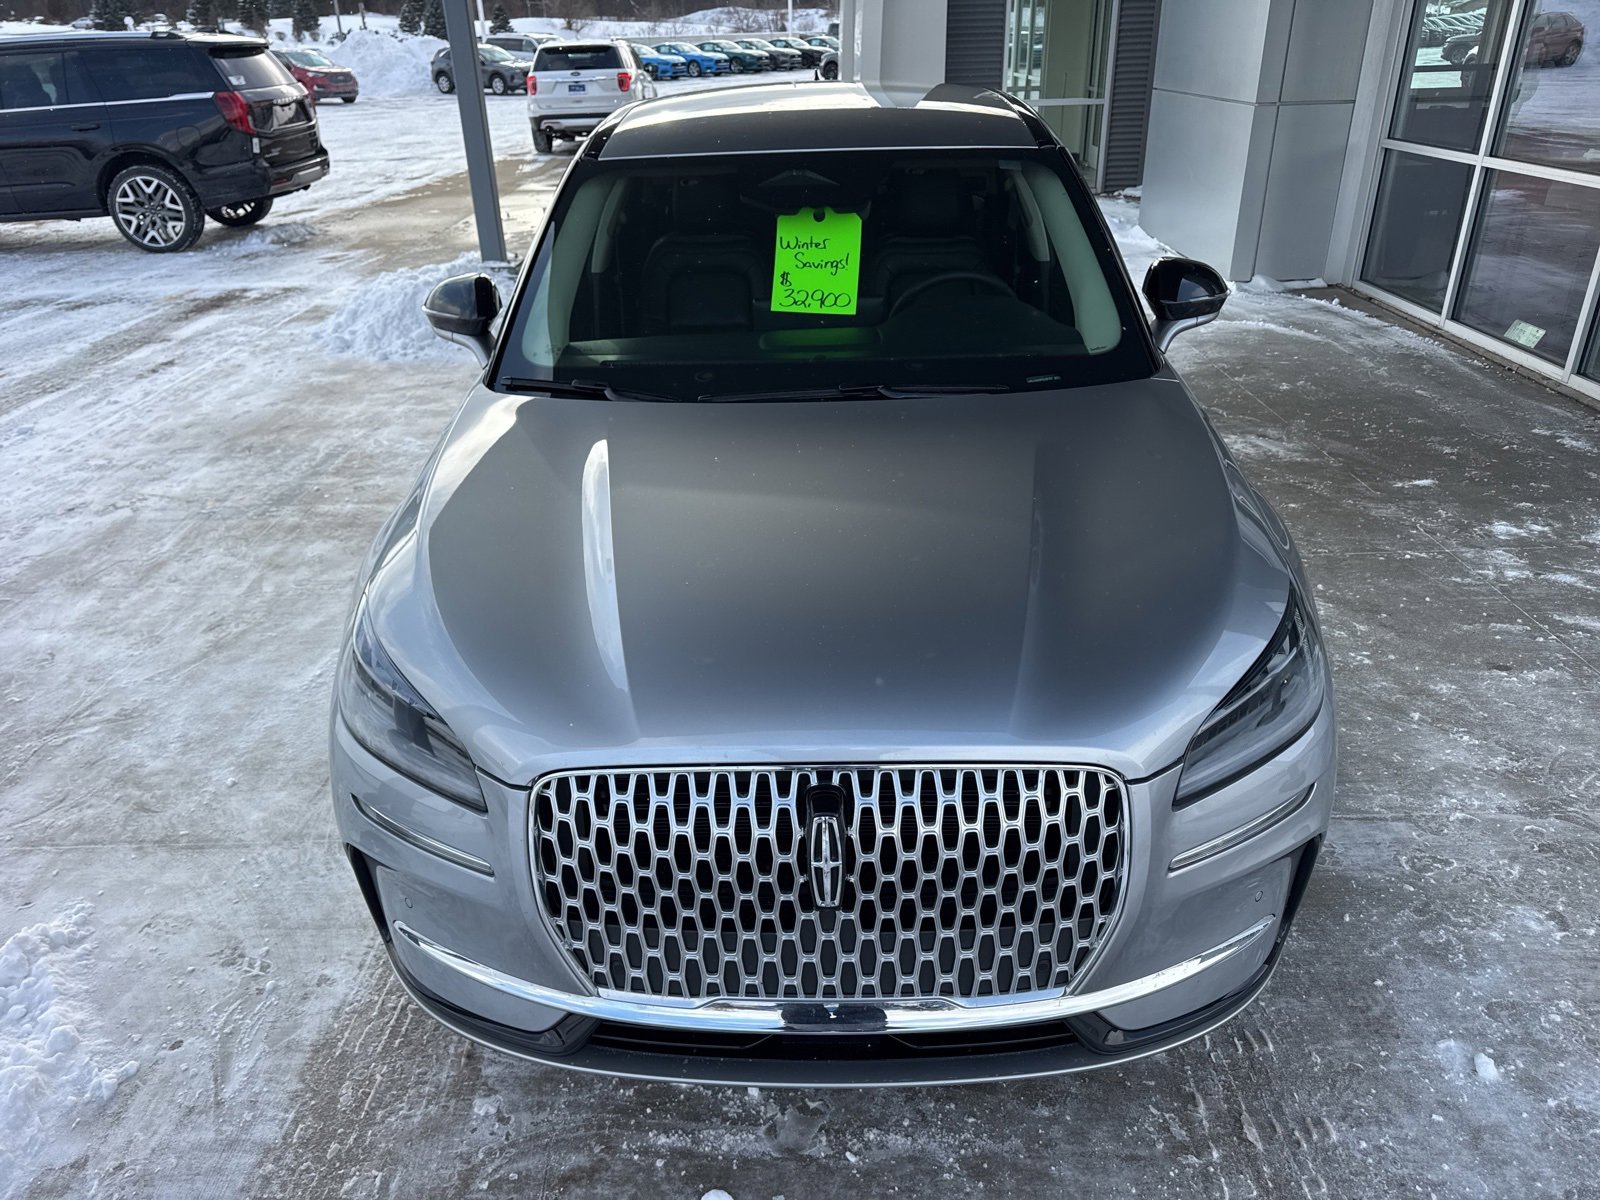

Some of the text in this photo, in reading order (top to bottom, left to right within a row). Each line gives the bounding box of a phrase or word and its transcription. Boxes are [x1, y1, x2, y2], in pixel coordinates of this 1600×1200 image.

[780, 236, 830, 250] Winter
[794, 252, 850, 276] Savings!
[780, 271, 792, 287] $
